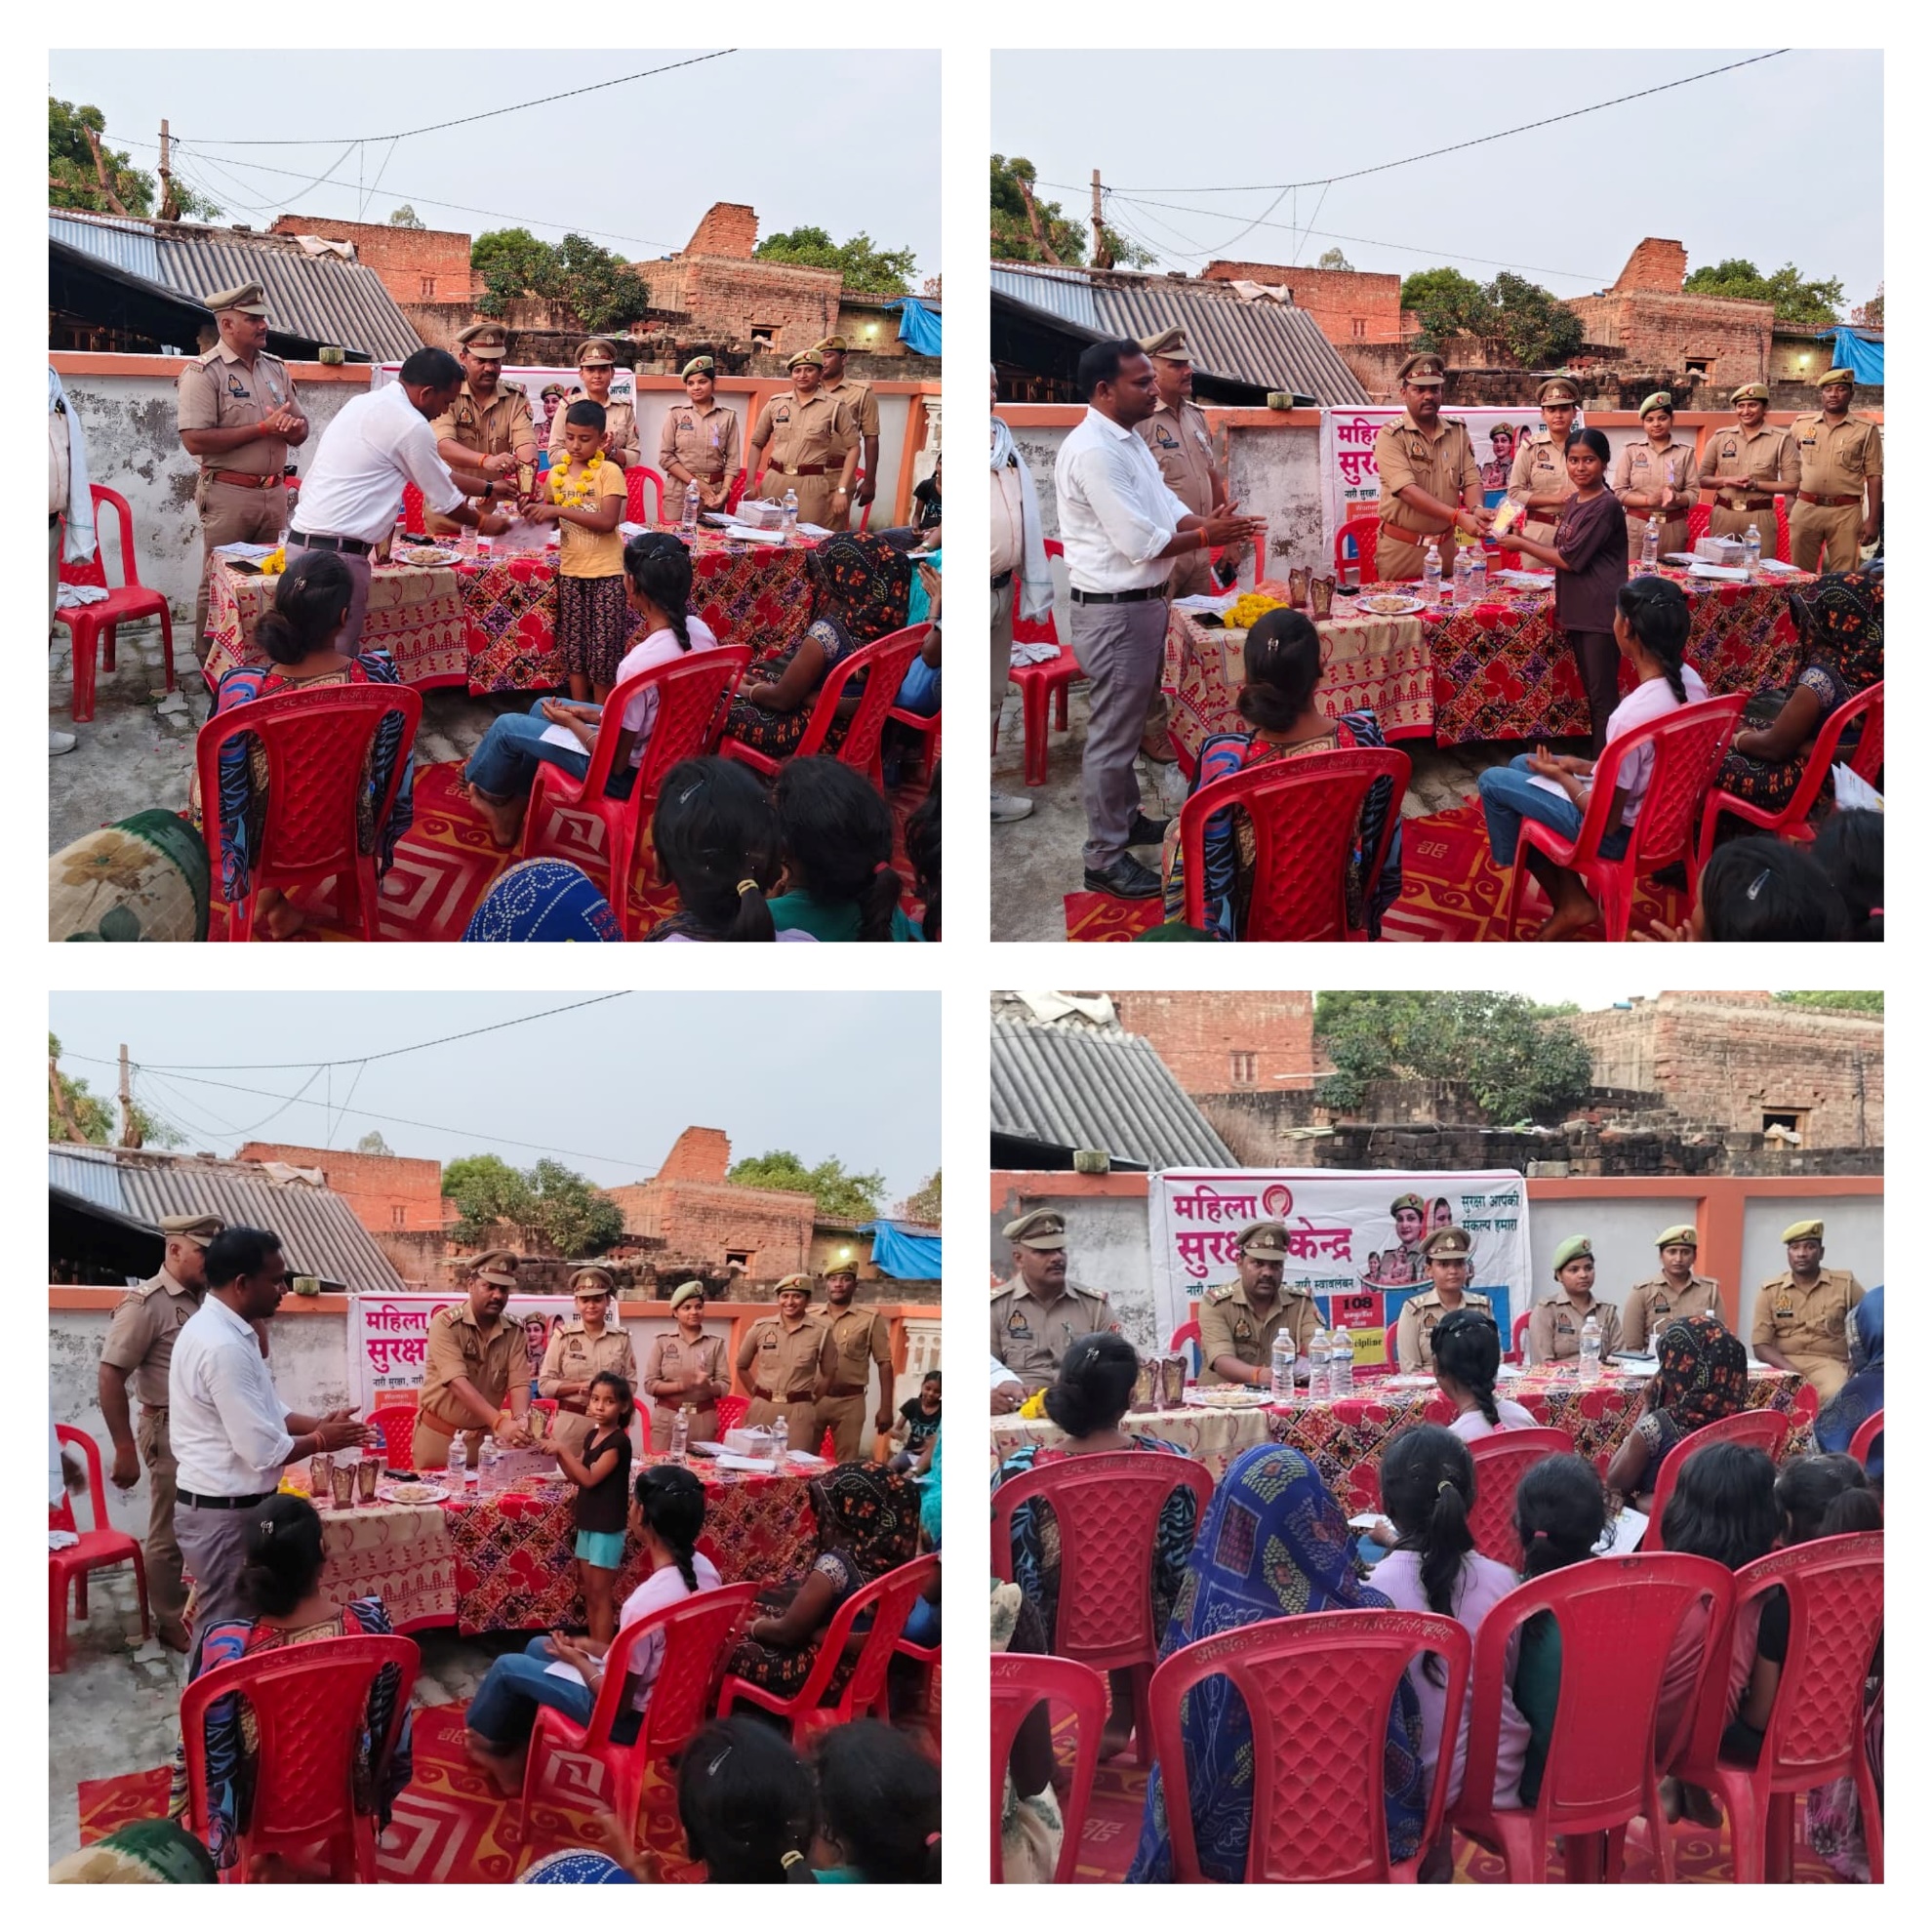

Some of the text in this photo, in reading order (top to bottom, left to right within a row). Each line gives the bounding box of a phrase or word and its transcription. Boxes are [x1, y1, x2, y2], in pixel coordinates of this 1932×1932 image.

[1337, 418, 1383, 446] महि
[1338, 451, 1380, 485] सुर
[1345, 488, 1357, 499] नारी
[1173, 1185, 1258, 1224] महिला
[1461, 1189, 1519, 1214] सुरक्षा आपकी
[1494, 1218, 1517, 1232] हमारा
[1176, 1230, 1239, 1278] सुर
[1186, 1281, 1203, 1296] नारी
[1343, 1297, 1373, 1309] 108
[366, 1305, 426, 1333] महिला
[366, 1339, 427, 1374] सुरक्ष
[373, 1376, 386, 1387] नारी
